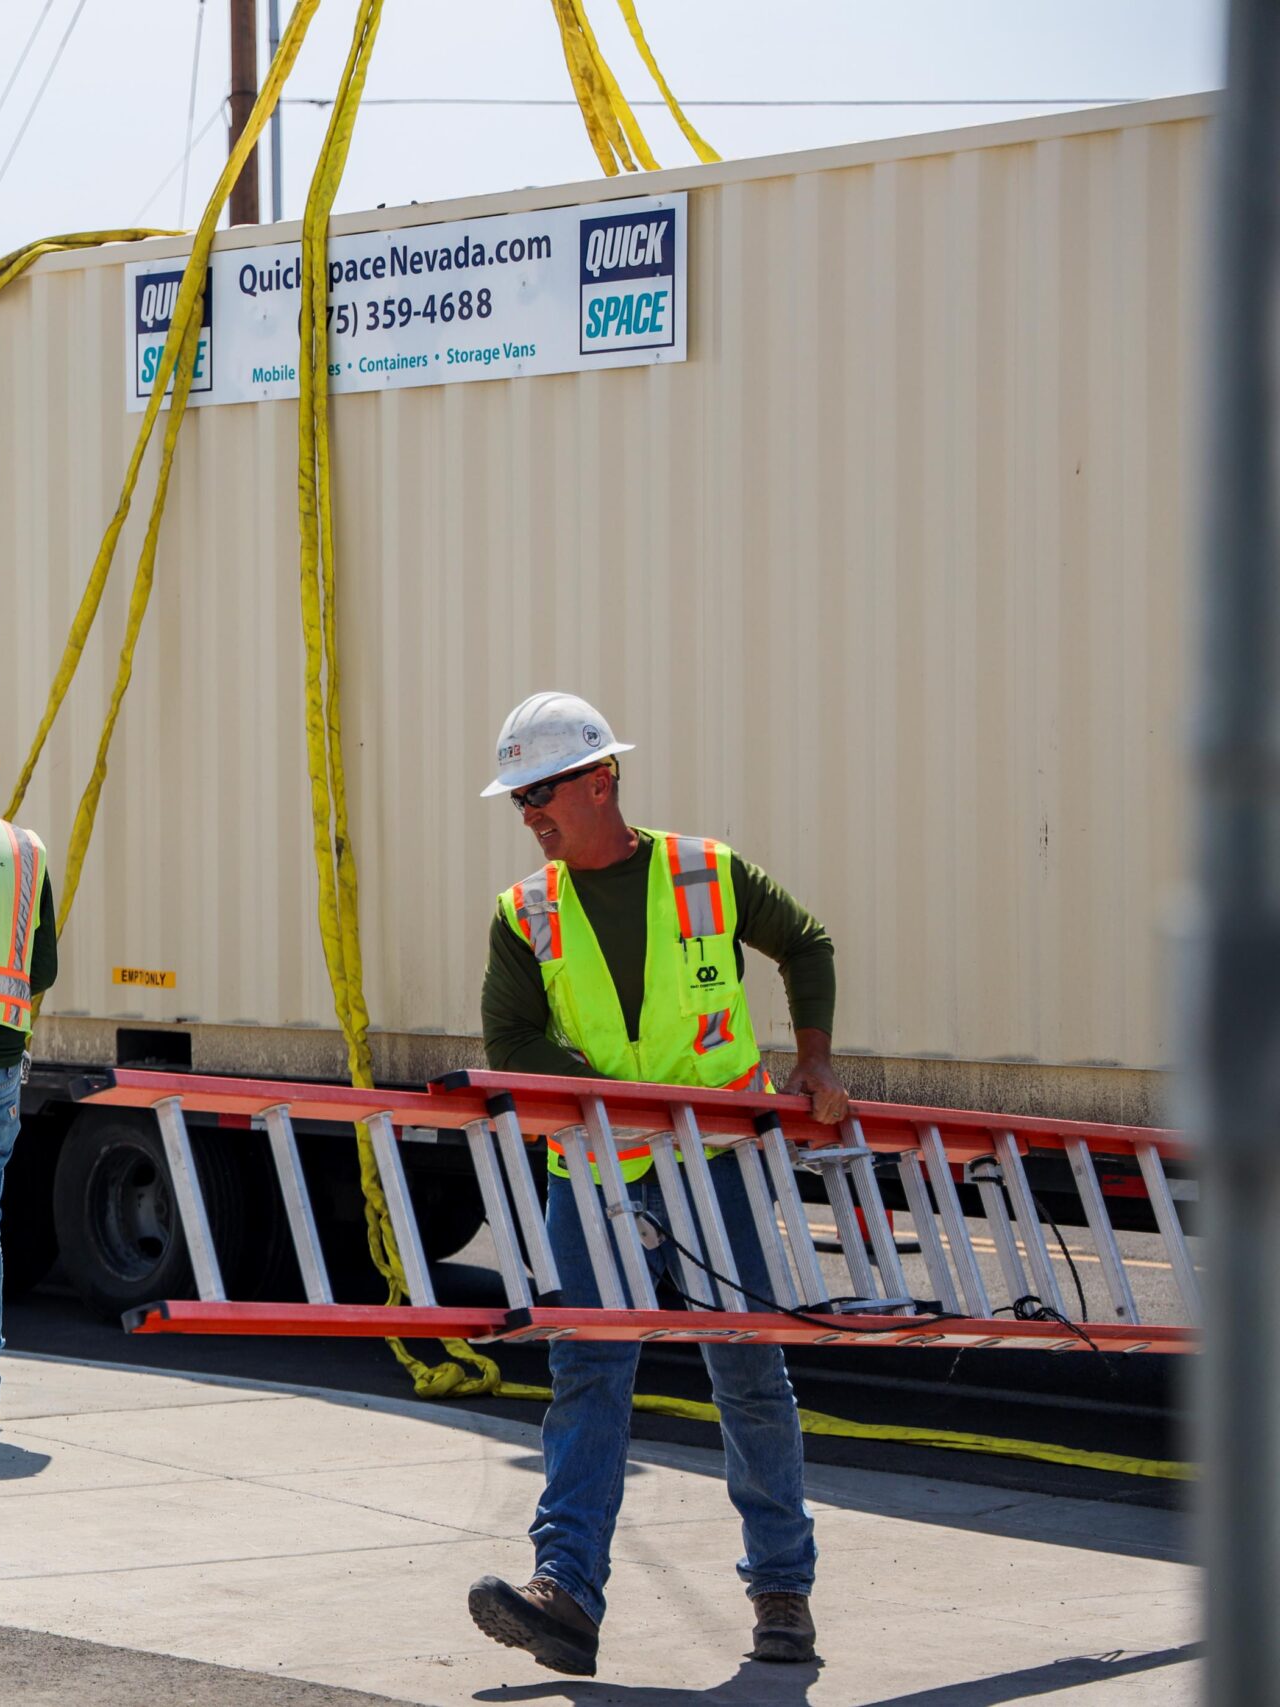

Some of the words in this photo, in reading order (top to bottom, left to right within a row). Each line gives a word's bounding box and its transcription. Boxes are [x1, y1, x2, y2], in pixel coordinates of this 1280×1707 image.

[239, 234, 552, 297] QuicpaceNevada.com
[585, 221, 668, 277] QUICK
[140, 282, 182, 328] QUI
[298, 302, 358, 339] (75)
[366, 288, 493, 331] 359-4688
[585, 290, 668, 339] SPACE
[252, 364, 295, 383] Mobile
[358, 353, 428, 374] Containers
[446, 347, 500, 365] Storage
[503, 342, 536, 359] Vans
